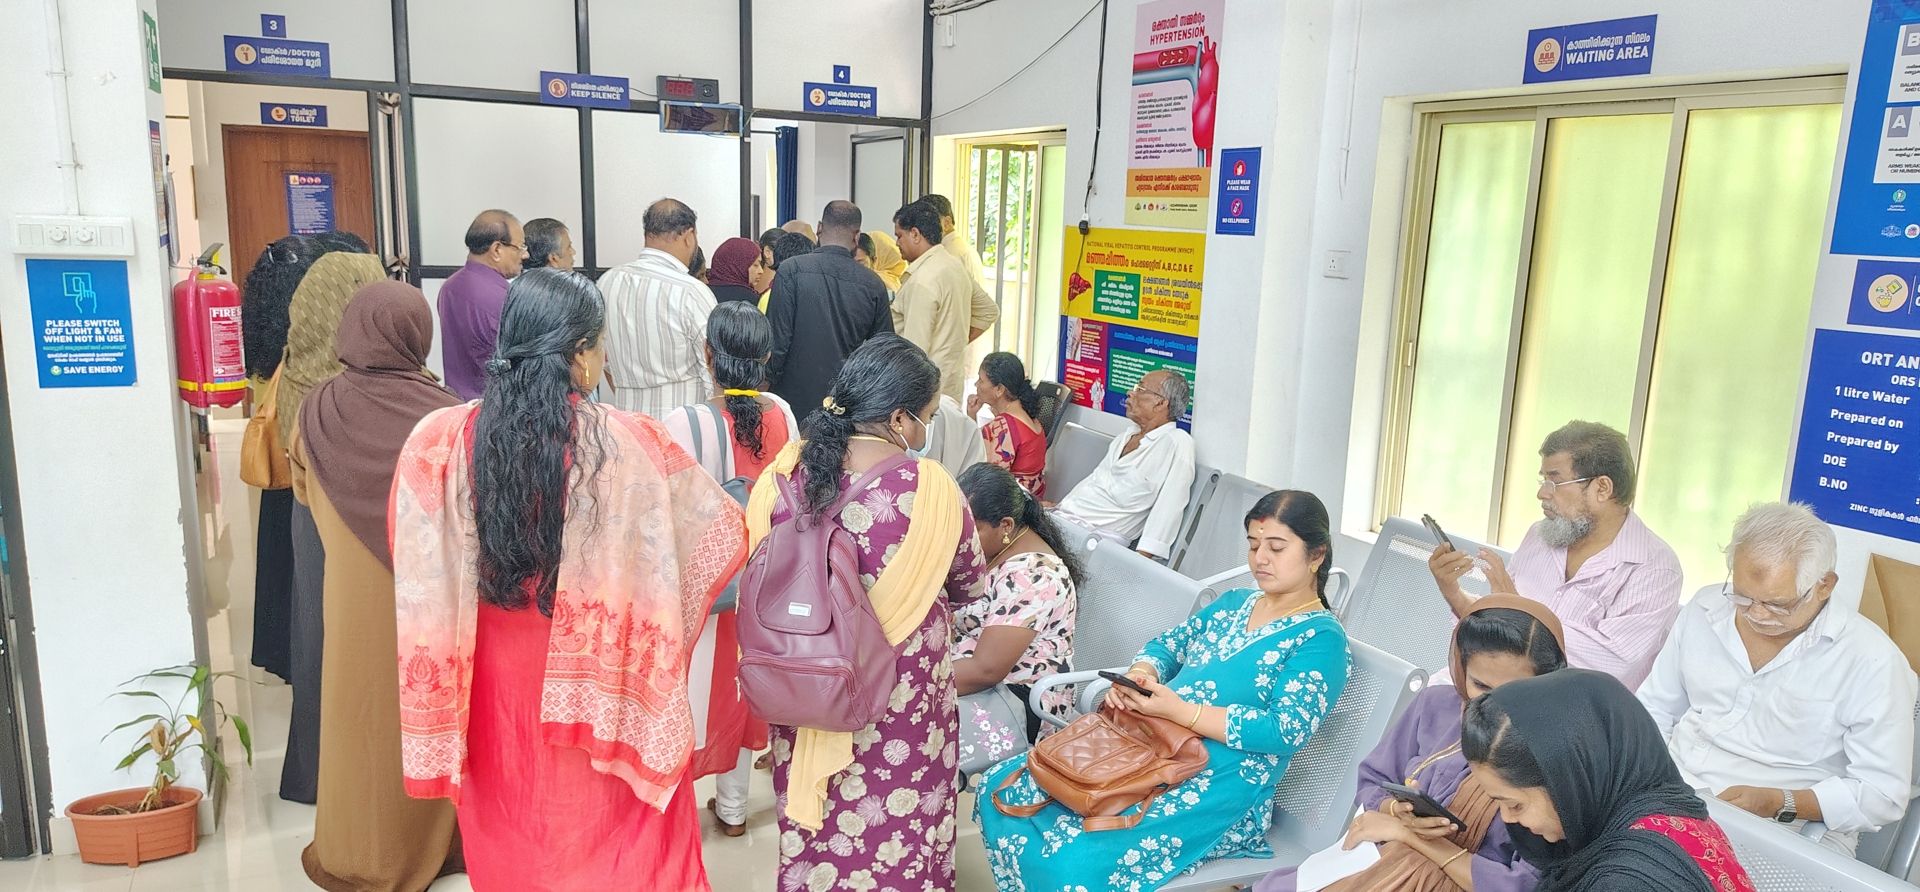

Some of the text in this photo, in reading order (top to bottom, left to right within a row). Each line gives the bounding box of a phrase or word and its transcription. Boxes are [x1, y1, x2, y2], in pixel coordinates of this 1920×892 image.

[269, 20, 278, 31] 3
[1150, 26, 1206, 46] HYPERTENSION
[1566, 46, 1649, 65] WAITING AREA
[838, 70, 845, 79] 4
[571, 90, 621, 100] KEEP SILENCE
[815, 95, 821, 103] 2
[1891, 114, 1907, 129] A
[1152, 245, 1177, 253] PROGRAMME
[1162, 262, 1183, 273] A,B,C,D
[1189, 264, 1193, 273] E
[46, 319, 120, 328] PLEASE SWITCH
[65, 327, 93, 335] LIGHT
[103, 327, 122, 335] FAN
[43, 335, 73, 343] WHEN
[75, 335, 93, 343] NOT
[1861, 351, 1894, 367] ORT
[63, 366, 87, 374] SAVE
[1891, 375, 1916, 386] ORS
[1835, 386, 1911, 405] 1 litre Water
[1830, 409, 1904, 429] Prepared on
[1827, 432, 1899, 454] Prepared by
[1823, 454, 1847, 467] DOE
[1819, 477, 1848, 490] B.NO
[1849, 503, 1868, 513] ZINC
